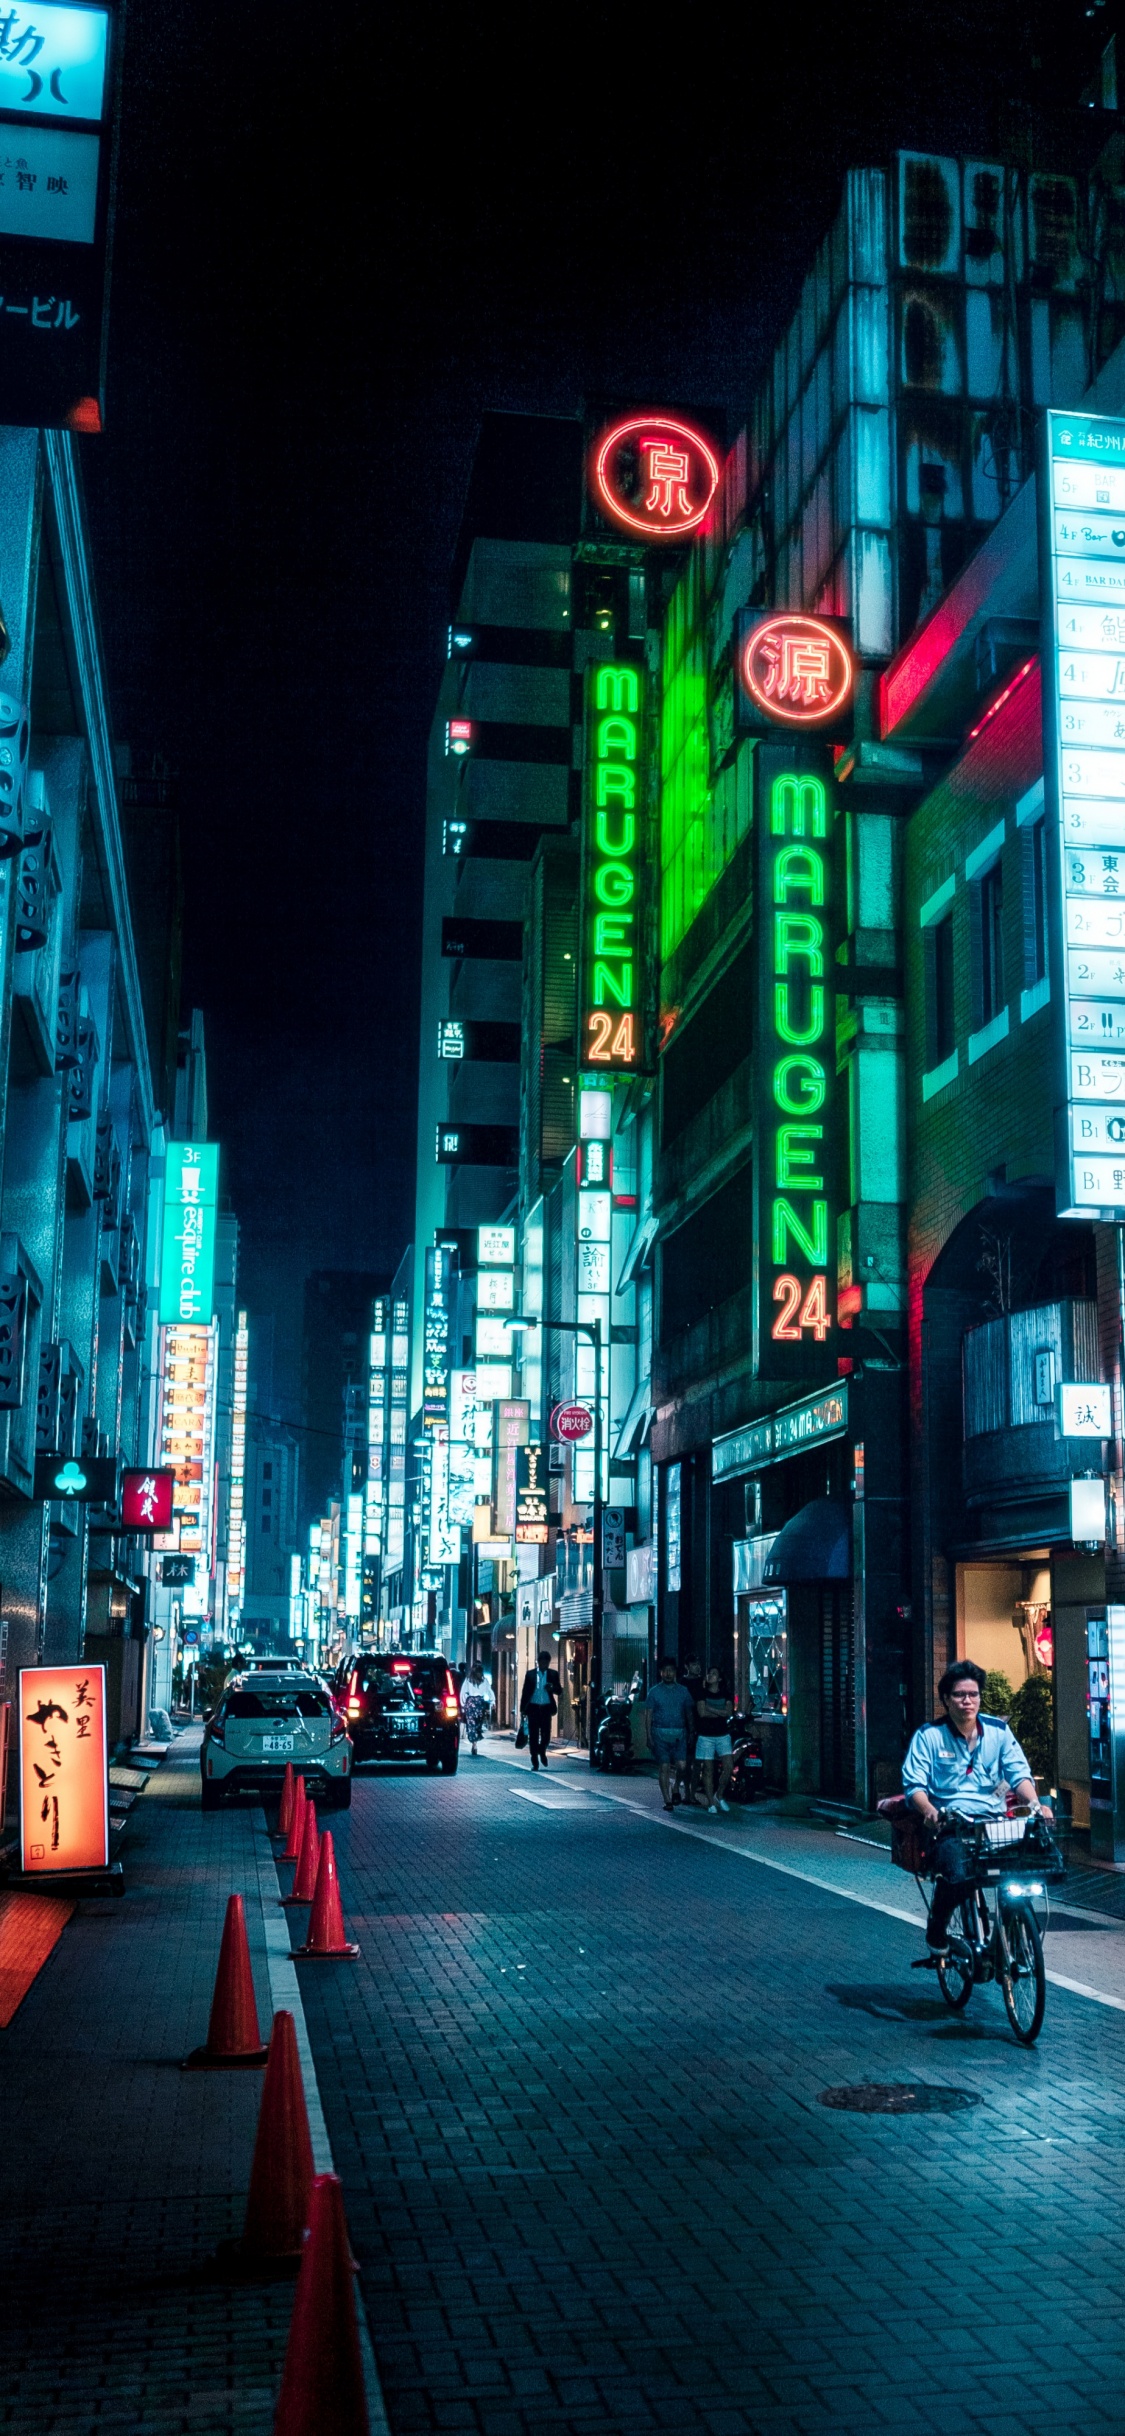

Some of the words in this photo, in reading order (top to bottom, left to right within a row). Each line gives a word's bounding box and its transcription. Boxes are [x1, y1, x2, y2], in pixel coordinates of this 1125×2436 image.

[0, 296, 81, 330] ービル
[1087, 433, 1125, 451] 紀州
[1086, 575, 1106, 585] BAR
[1109, 577, 1125, 587] DA
[595, 665, 638, 1007] MARUGEN
[588, 1012, 635, 1062] 24
[771, 773, 827, 1267] MARUGEN
[183, 1147, 202, 1163] 3F
[174, 1206, 200, 1275] esquire
[179, 1277, 201, 1319] club
[772, 1275, 831, 1343] 24
[561, 1416, 591, 1431] 消火栓
[26, 1699, 69, 1851] やきとり
